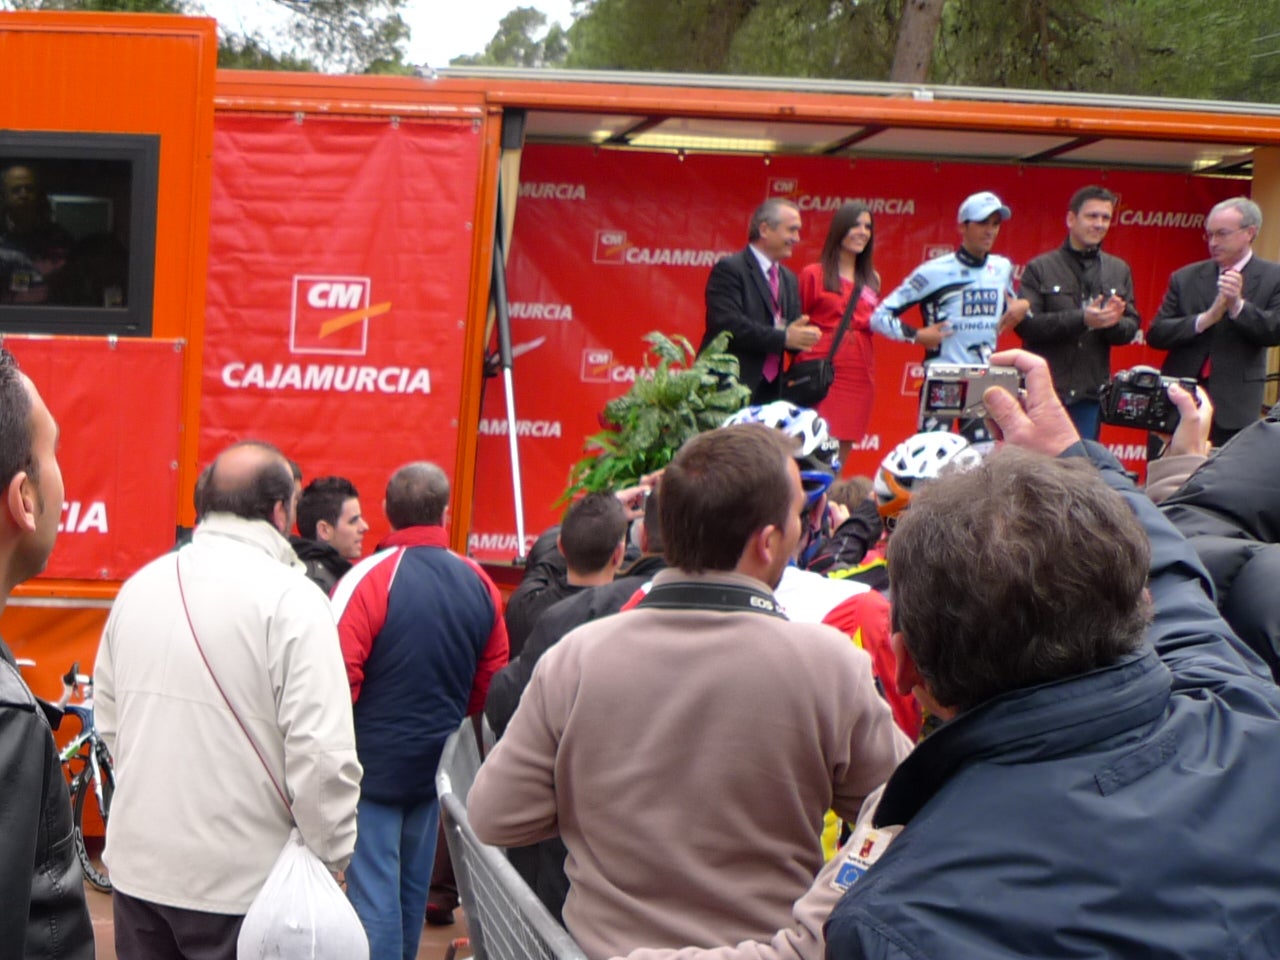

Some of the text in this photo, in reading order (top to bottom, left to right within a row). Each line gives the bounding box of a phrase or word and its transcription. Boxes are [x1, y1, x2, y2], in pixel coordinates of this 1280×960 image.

[519, 183, 586, 200] MURCIA
[307, 282, 363, 309] CM
[507, 303, 573, 320] MURCIA
[222, 361, 431, 394] CAJAMURCIA
[750, 596, 773, 611] EOS
